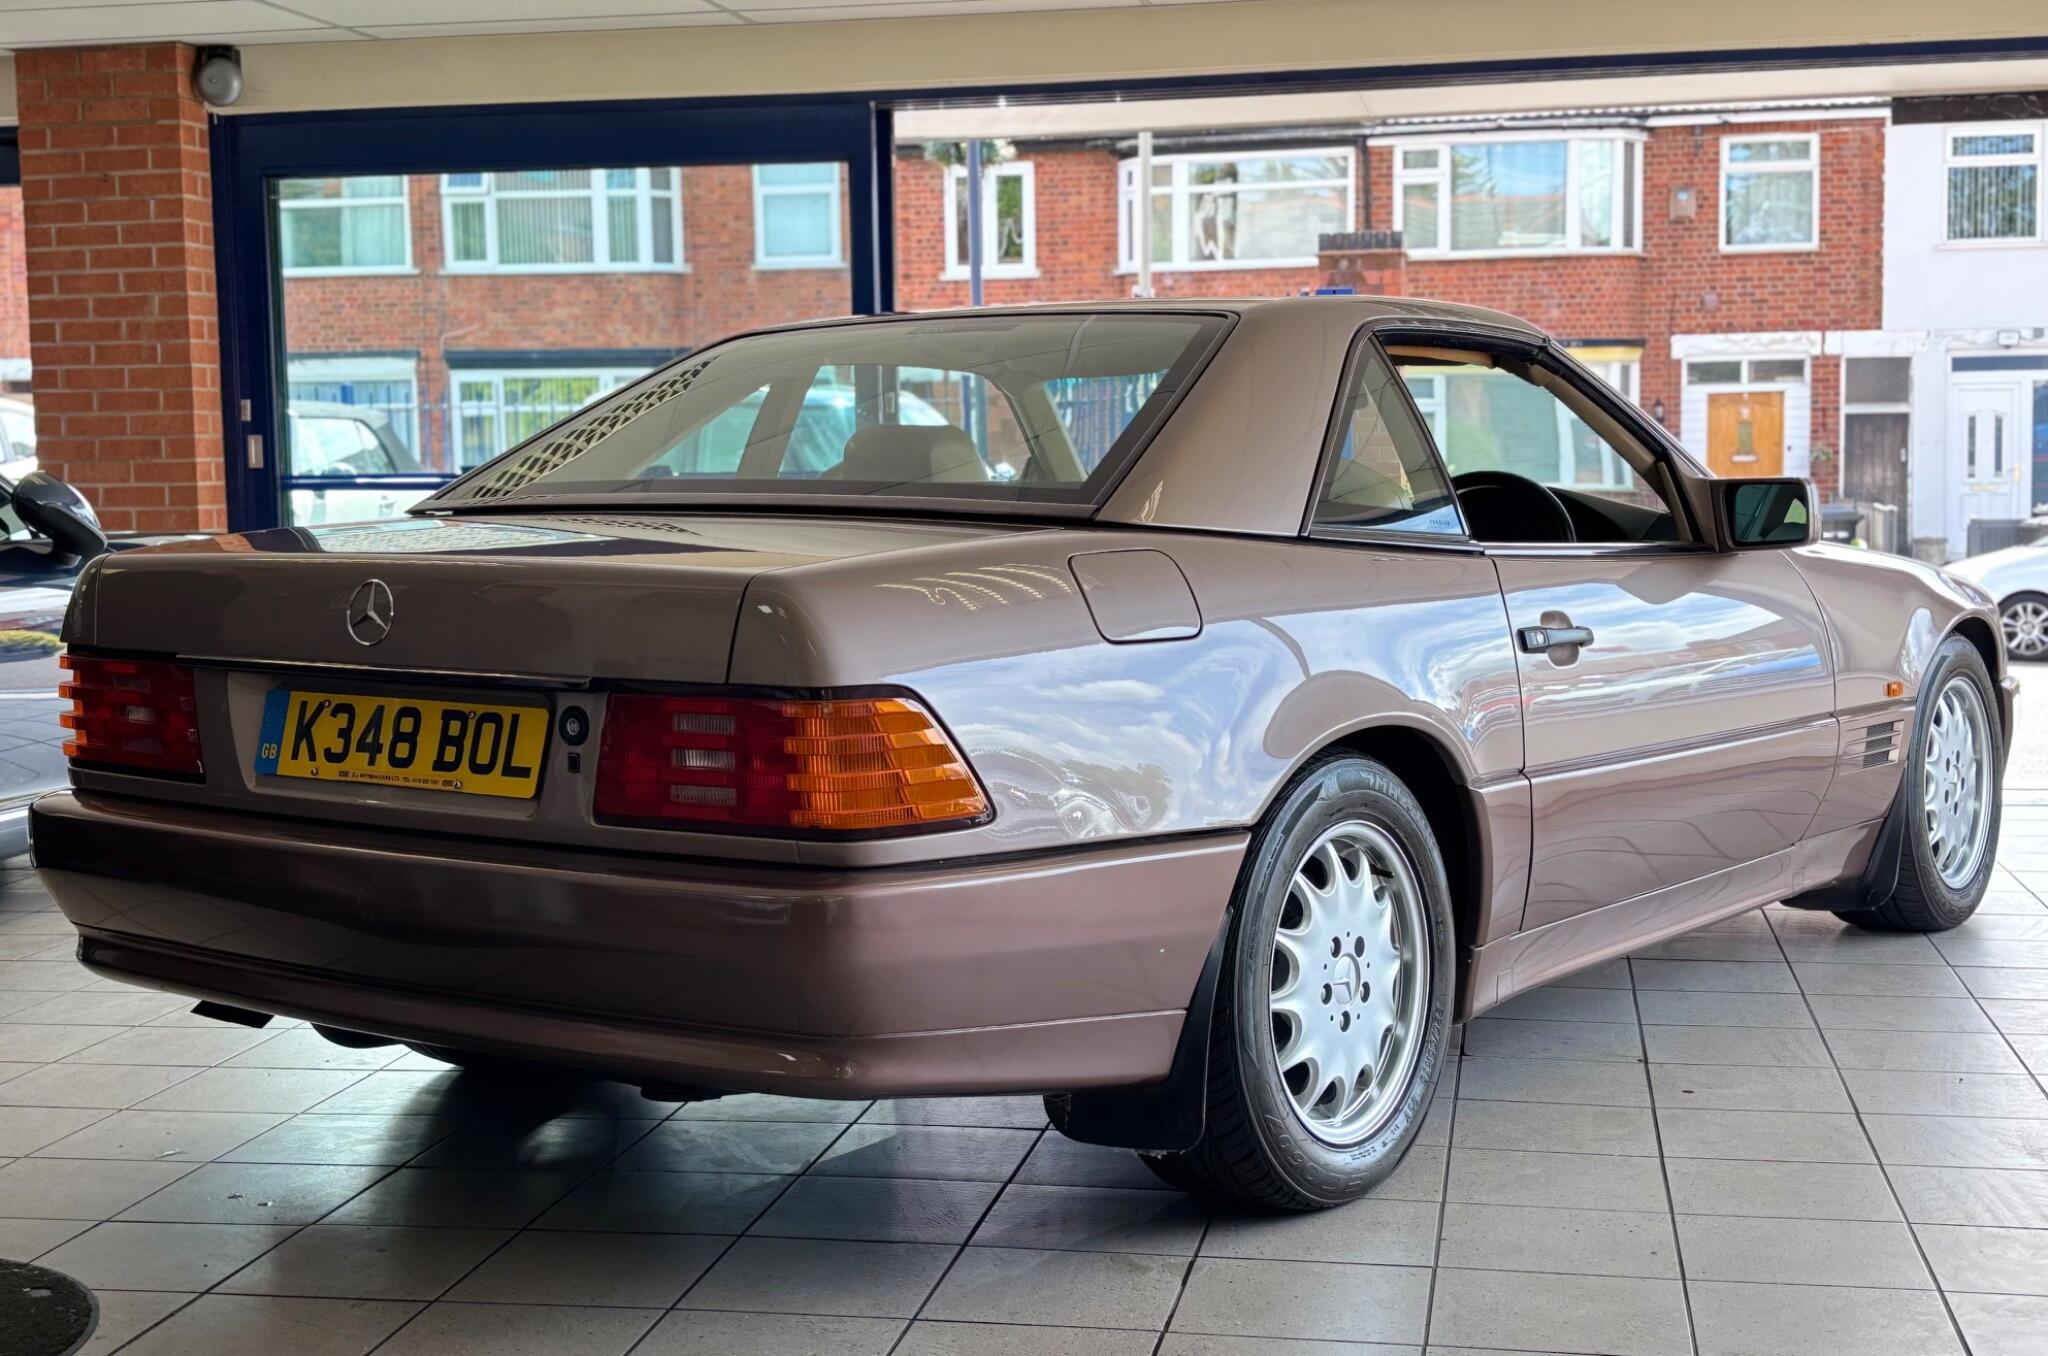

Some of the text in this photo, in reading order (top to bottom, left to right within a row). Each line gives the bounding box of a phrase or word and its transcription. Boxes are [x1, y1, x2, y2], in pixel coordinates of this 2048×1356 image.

[261, 743, 278, 759] GB
[291, 700, 532, 779] K348 BOL
